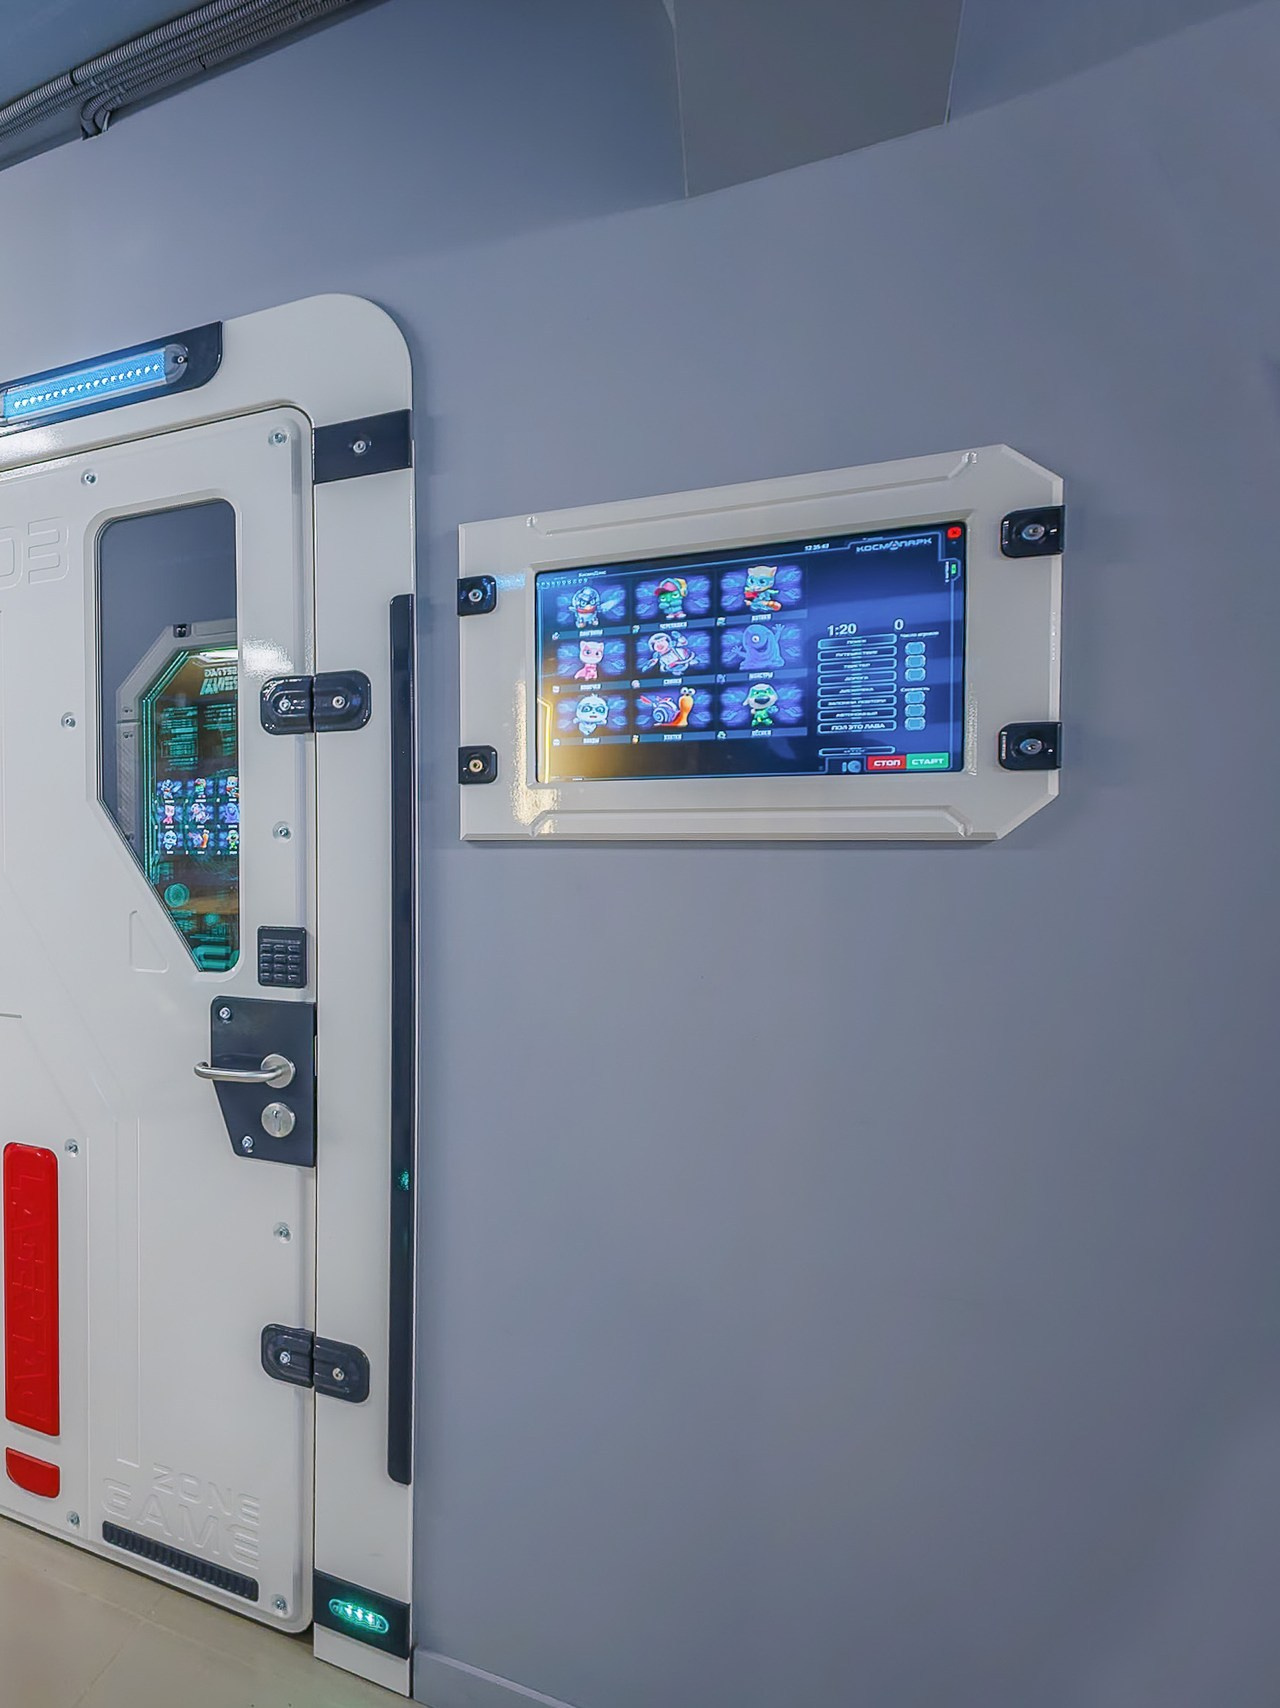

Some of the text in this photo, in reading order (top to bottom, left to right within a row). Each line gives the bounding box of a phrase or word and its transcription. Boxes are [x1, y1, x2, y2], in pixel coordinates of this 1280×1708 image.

[826, 622, 858, 637] 1:20
[894, 619, 905, 631] 0
[873, 758, 902, 767] СТОП
[911, 757, 945, 767] СТАРТ
[152, 1462, 261, 1527] ZONE
[101, 1475, 261, 1571] GAME
